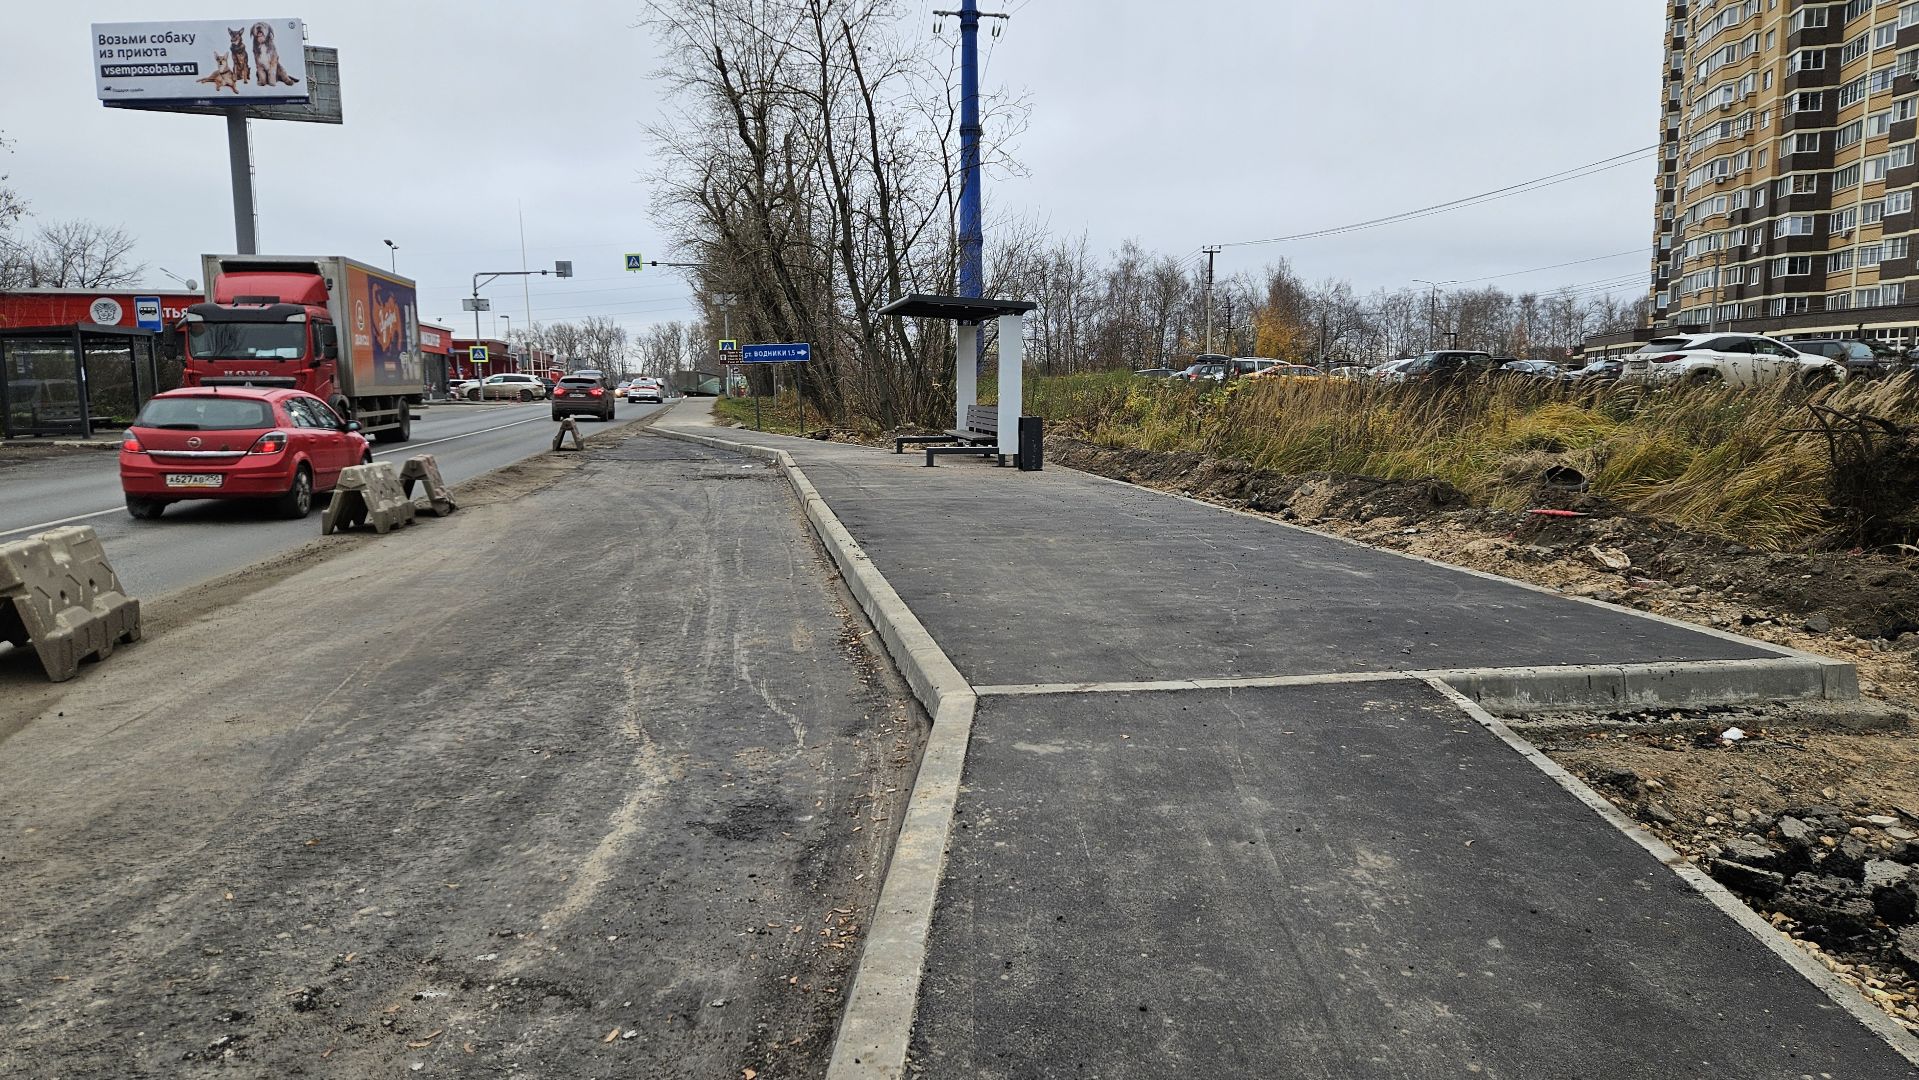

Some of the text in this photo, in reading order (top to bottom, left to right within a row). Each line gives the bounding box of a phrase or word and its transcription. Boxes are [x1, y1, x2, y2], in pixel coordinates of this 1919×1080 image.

[98, 31, 196, 46] Возьми собаку
[99, 47, 167, 60] из приюта
[103, 63, 195, 76] vsemposobake.ru
[753, 350, 787, 358] ВОДНИКИ
